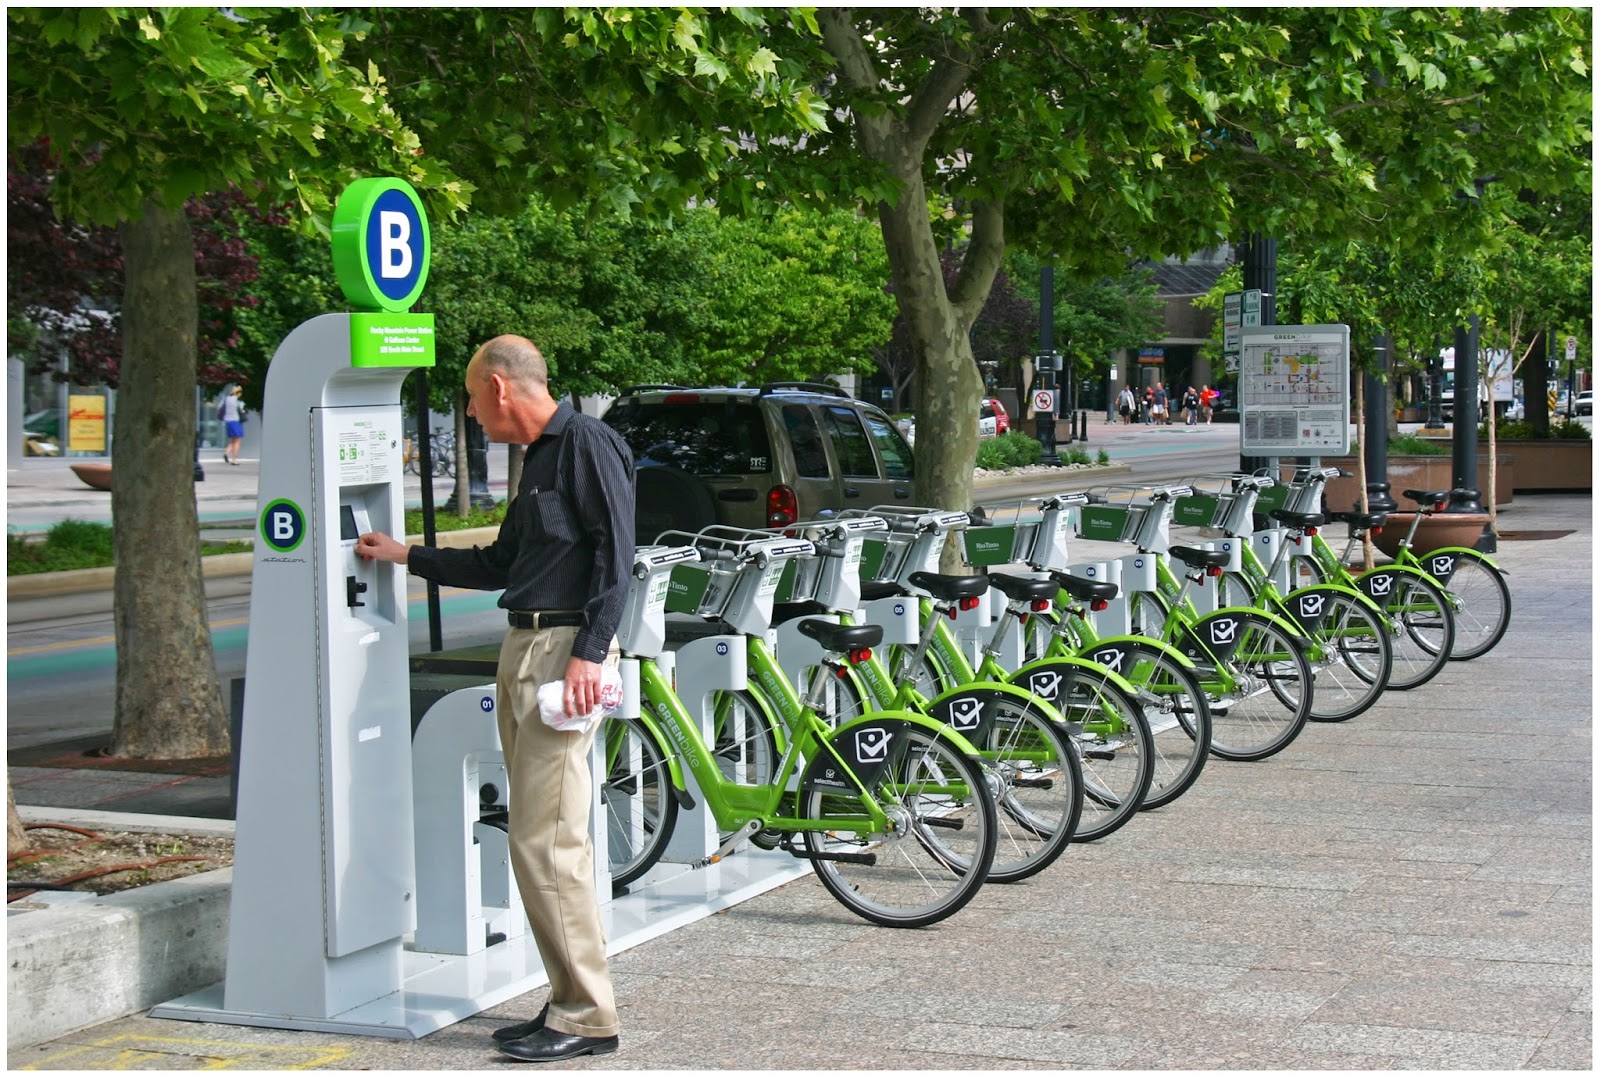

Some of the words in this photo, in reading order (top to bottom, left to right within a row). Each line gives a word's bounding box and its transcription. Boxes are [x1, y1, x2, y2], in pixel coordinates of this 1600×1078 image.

[380, 211, 413, 279] B
[274, 512, 294, 539] B
[717, 645, 727, 653] 03
[482, 700, 492, 709] 01
[658, 702, 700, 769] GREENbike
[813, 777, 846, 788] selecthealth
